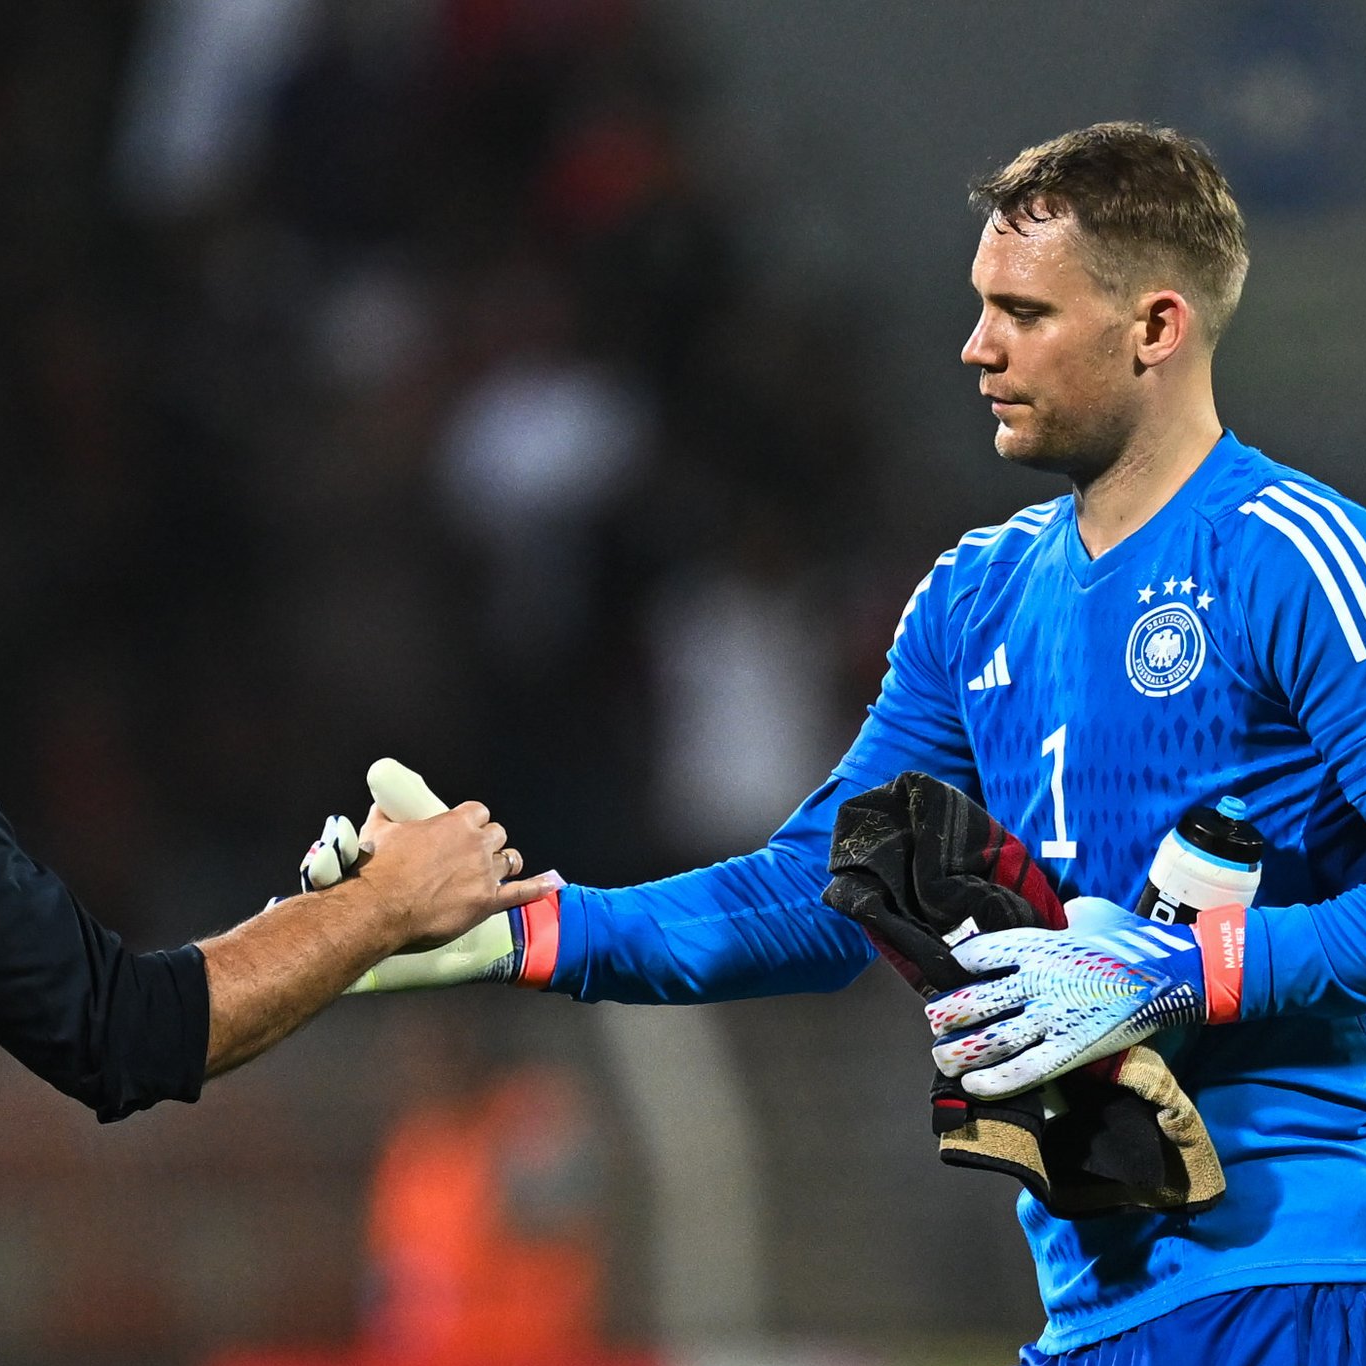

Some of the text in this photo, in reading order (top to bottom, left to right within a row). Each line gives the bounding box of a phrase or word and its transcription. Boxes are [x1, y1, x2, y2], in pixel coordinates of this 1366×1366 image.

[1145, 615, 1190, 632] DEUTSCHER
[1135, 658, 1190, 685] FUSSBALL-BUND
[1041, 723, 1077, 859] 1
[1220, 920, 1235, 969] MANUEL
